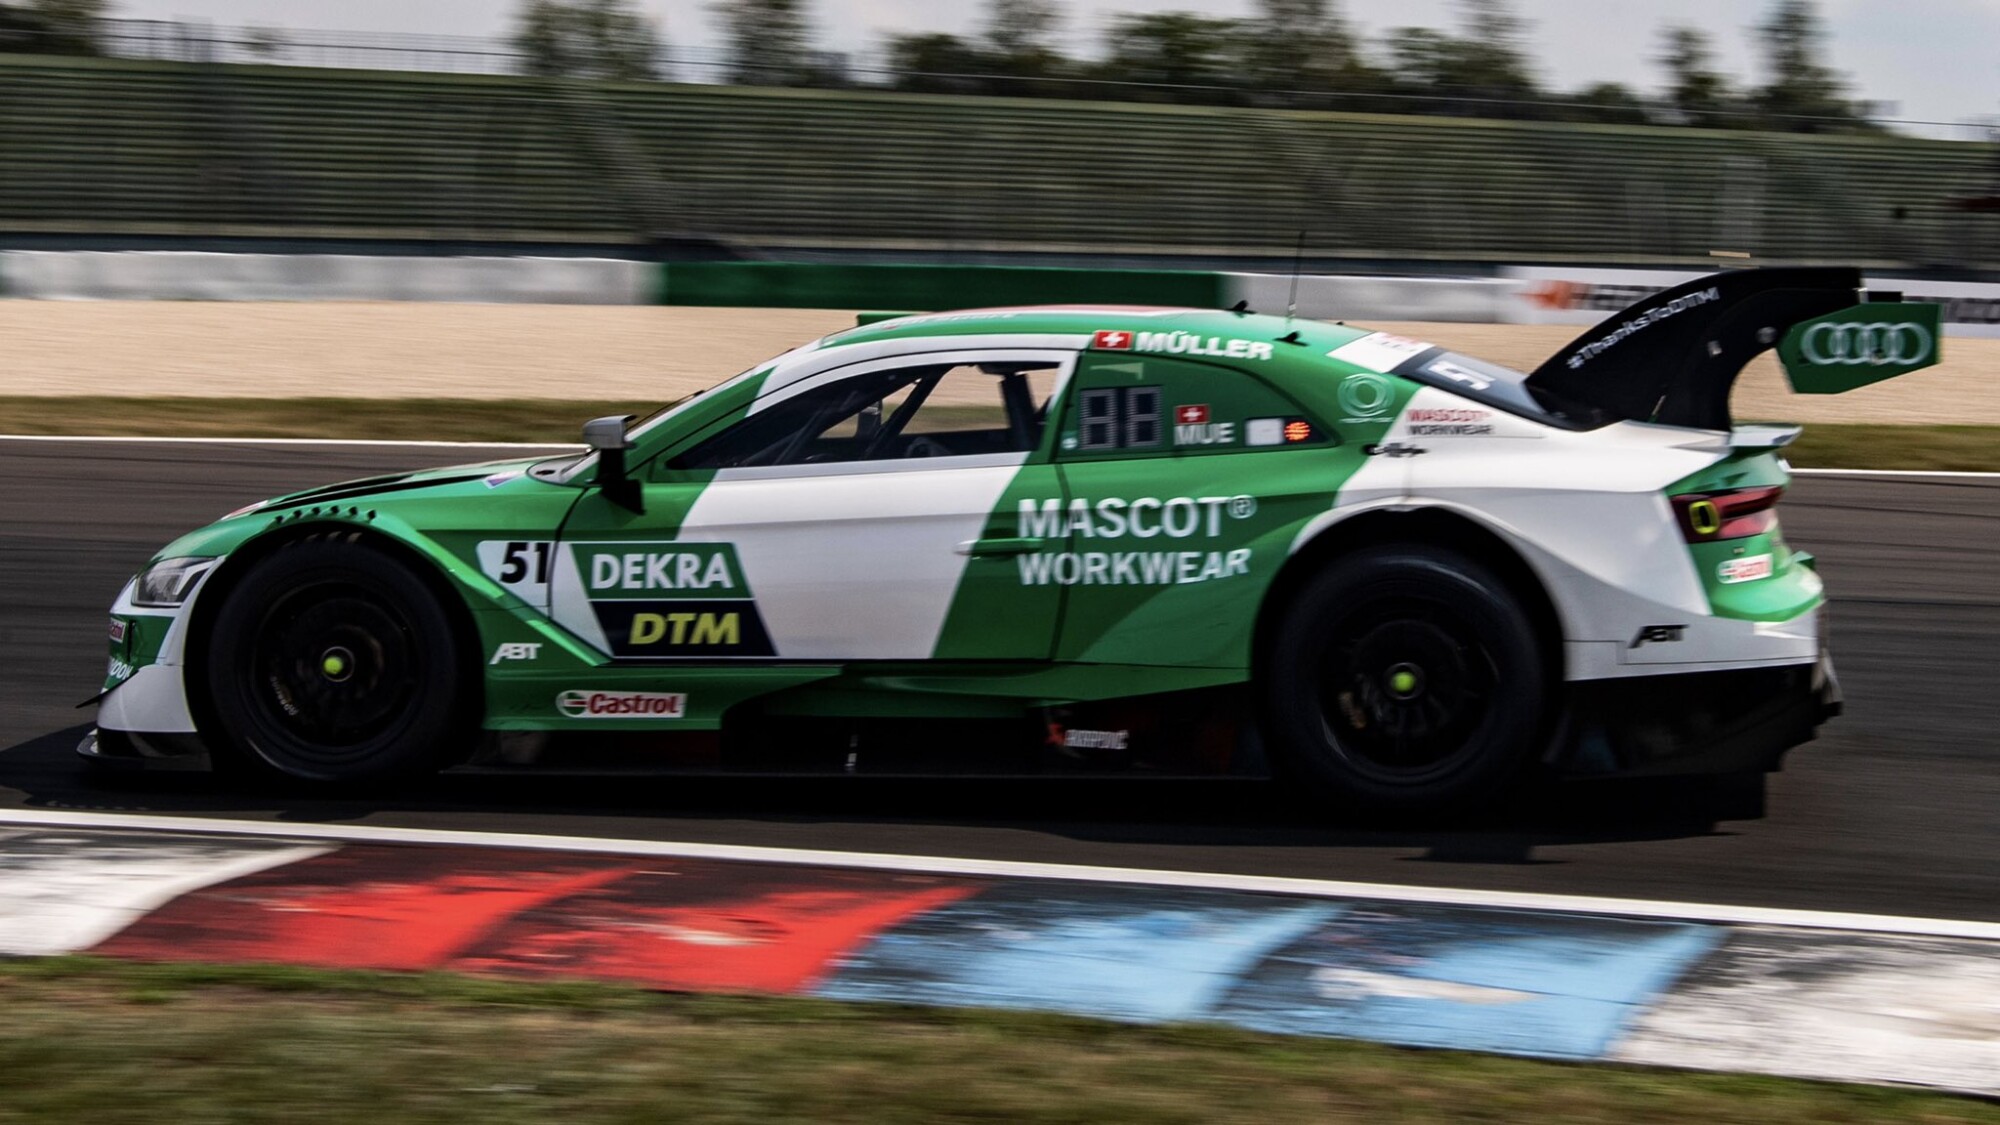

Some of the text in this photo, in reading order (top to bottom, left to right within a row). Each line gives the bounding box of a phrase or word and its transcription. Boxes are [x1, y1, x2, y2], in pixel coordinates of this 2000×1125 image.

[1134, 331, 1274, 360] MÜLLER
[1173, 422, 1236, 447] MUE
[499, 541, 550, 584] 51
[591, 552, 735, 589] DEKRA
[1017, 549, 1253, 586] WORKWEAR
[628, 612, 740, 645] DTM
[1628, 623, 1690, 649] ABT
[489, 642, 543, 665] ABT
[589, 692, 680, 715] Castrol
